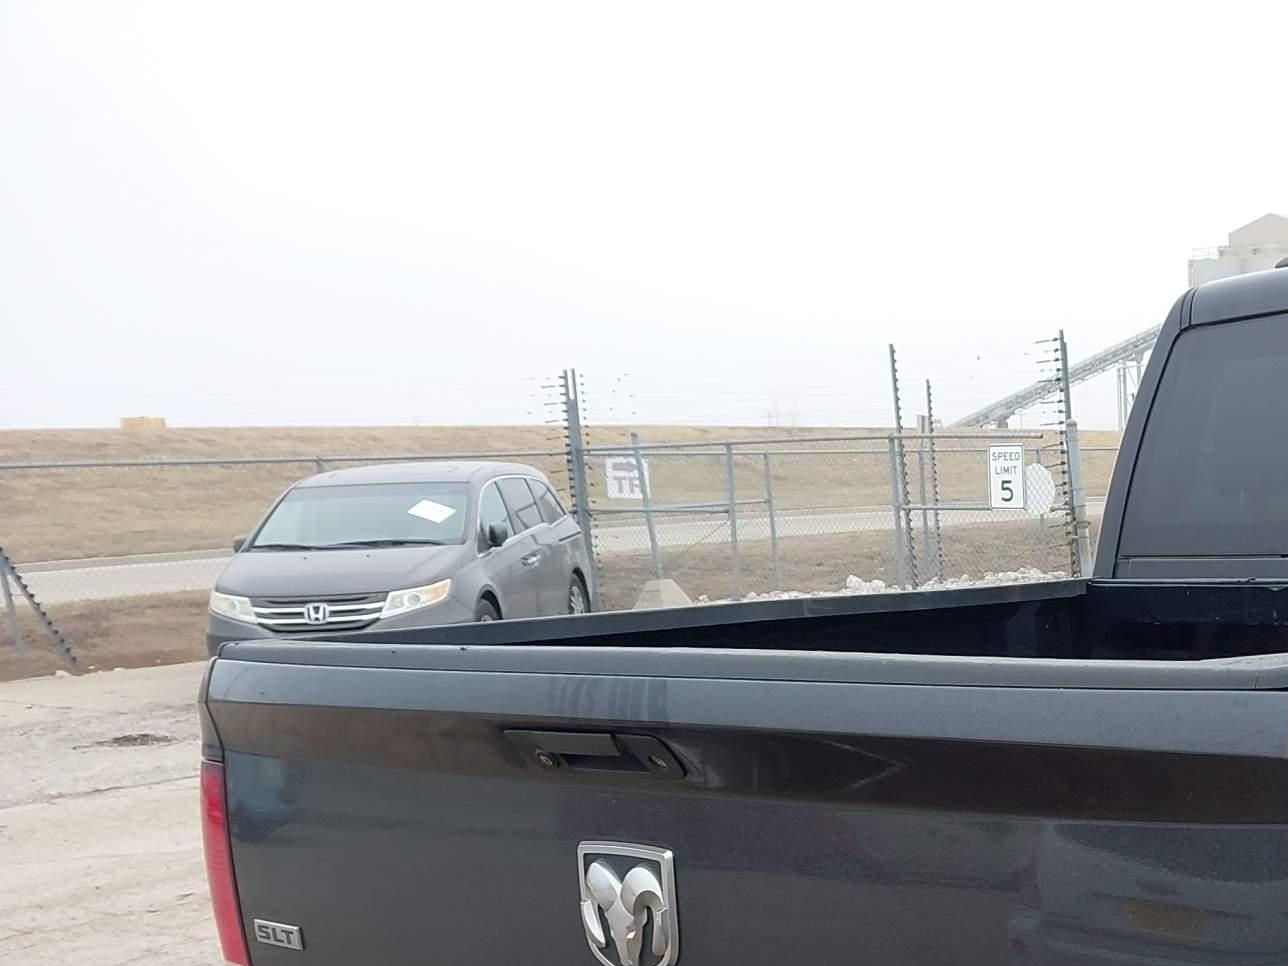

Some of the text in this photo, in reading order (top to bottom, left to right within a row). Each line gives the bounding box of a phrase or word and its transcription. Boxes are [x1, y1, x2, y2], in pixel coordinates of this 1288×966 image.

[991, 451, 1021, 461] SPEED
[994, 465, 1018, 475] LIMIT
[1000, 479, 1014, 502] 5
[257, 924, 295, 945] SLT
